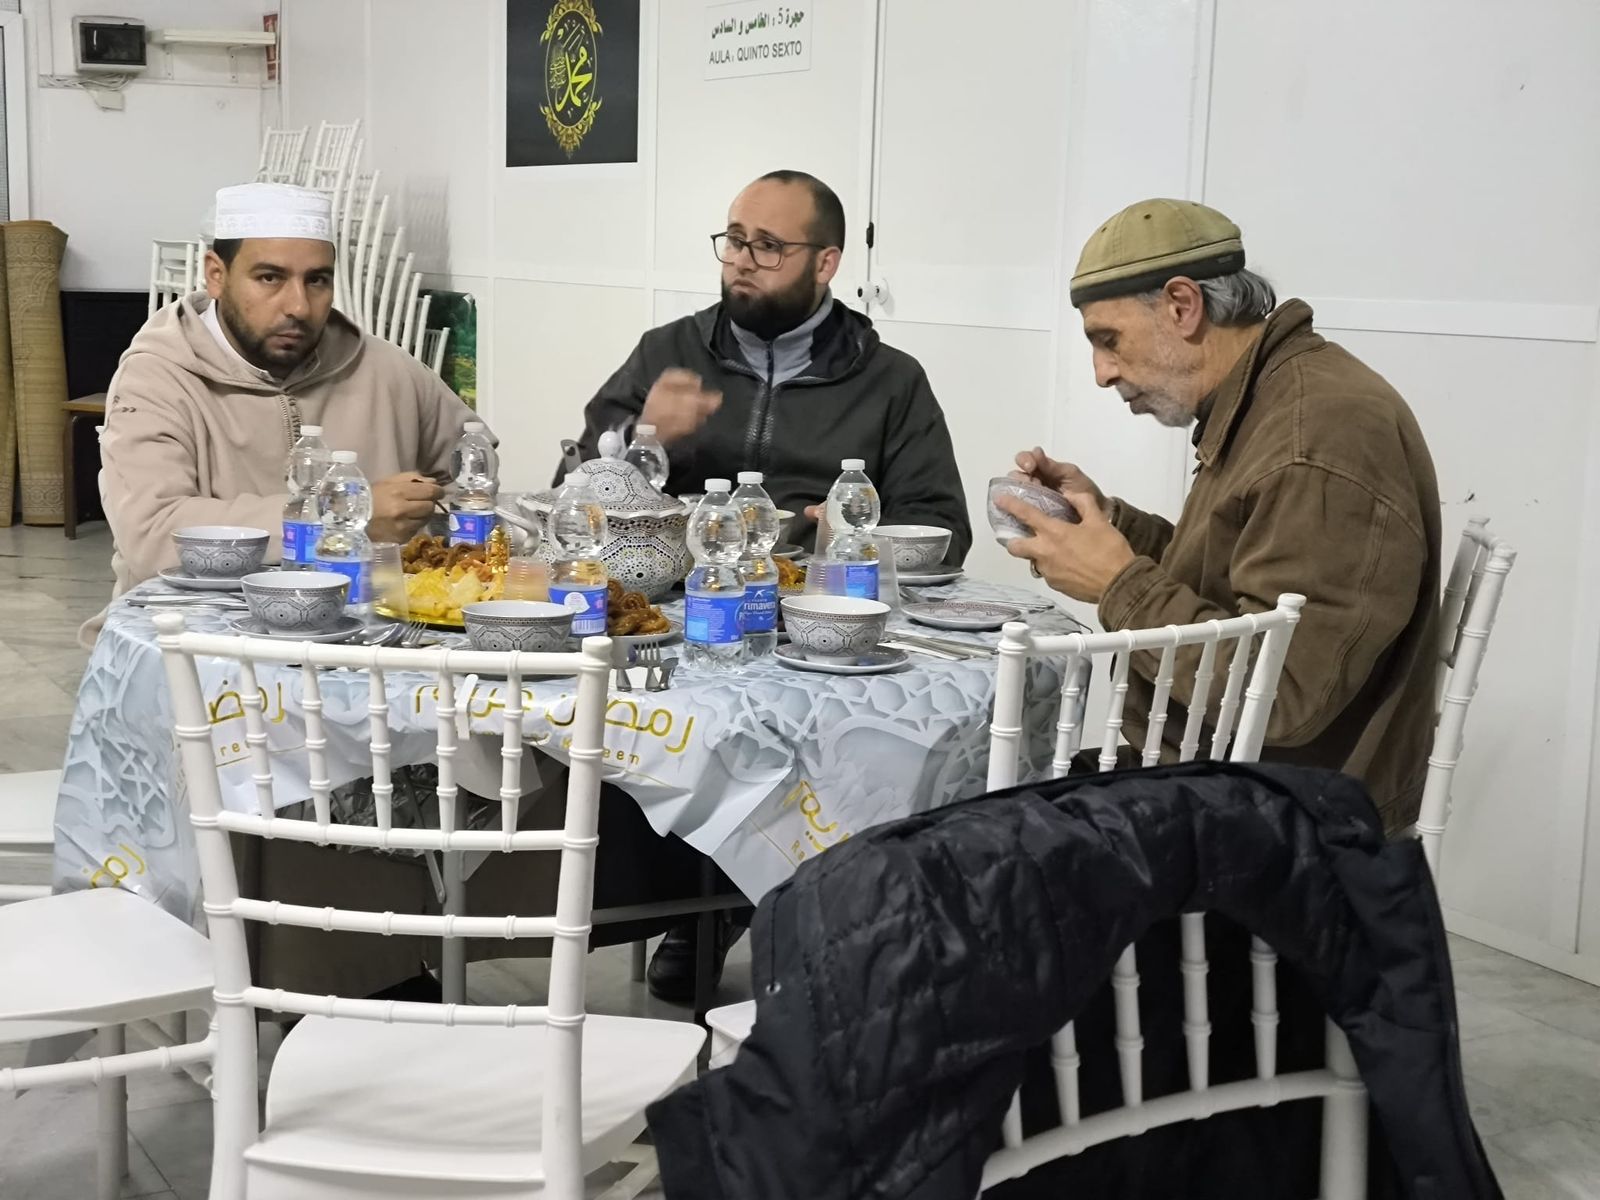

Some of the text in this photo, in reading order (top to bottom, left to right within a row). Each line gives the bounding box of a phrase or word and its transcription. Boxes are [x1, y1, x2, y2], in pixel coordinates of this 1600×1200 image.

[712, 17, 737, 39] السادس
[746, 12, 770, 34] الخامس
[737, 44, 769, 61] QUINTO
[772, 40, 802, 58] SEXTO
